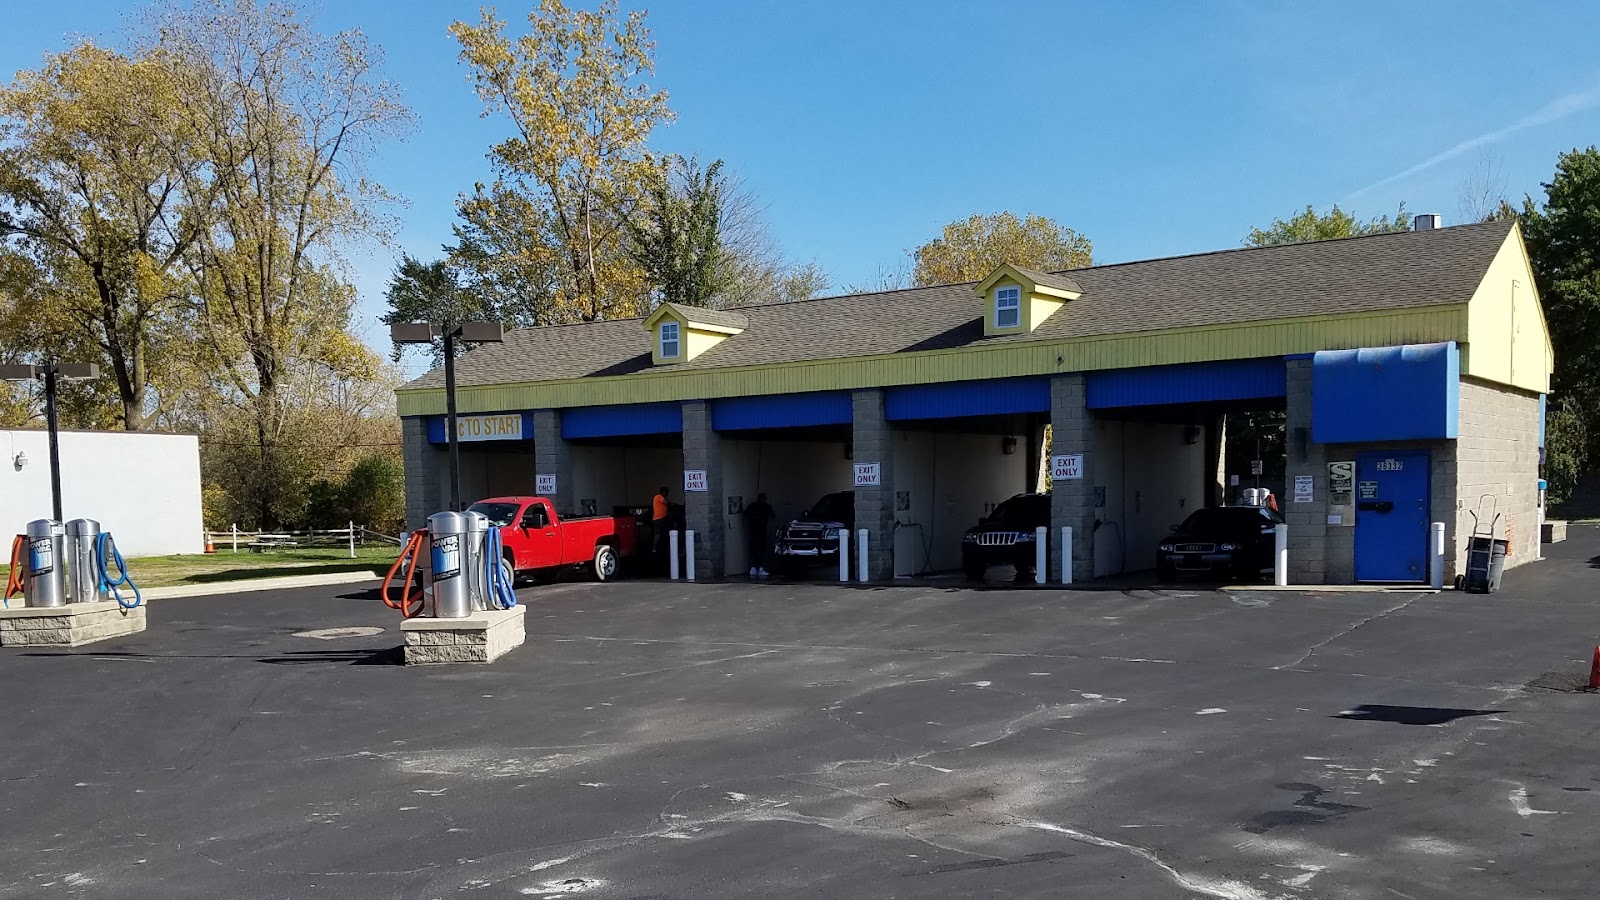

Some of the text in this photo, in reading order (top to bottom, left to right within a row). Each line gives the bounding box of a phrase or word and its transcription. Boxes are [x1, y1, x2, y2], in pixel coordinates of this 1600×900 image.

[465, 417, 480, 436] TO
[484, 416, 520, 435] START
[1058, 458, 1076, 467] EXIT
[859, 466, 874, 474] EXIT
[1055, 468, 1078, 476] ONLY
[857, 475, 877, 483] ONLY
[431, 536, 459, 548] POWER
[37, 545, 52, 553] VAC
[441, 543, 459, 553] VAC
